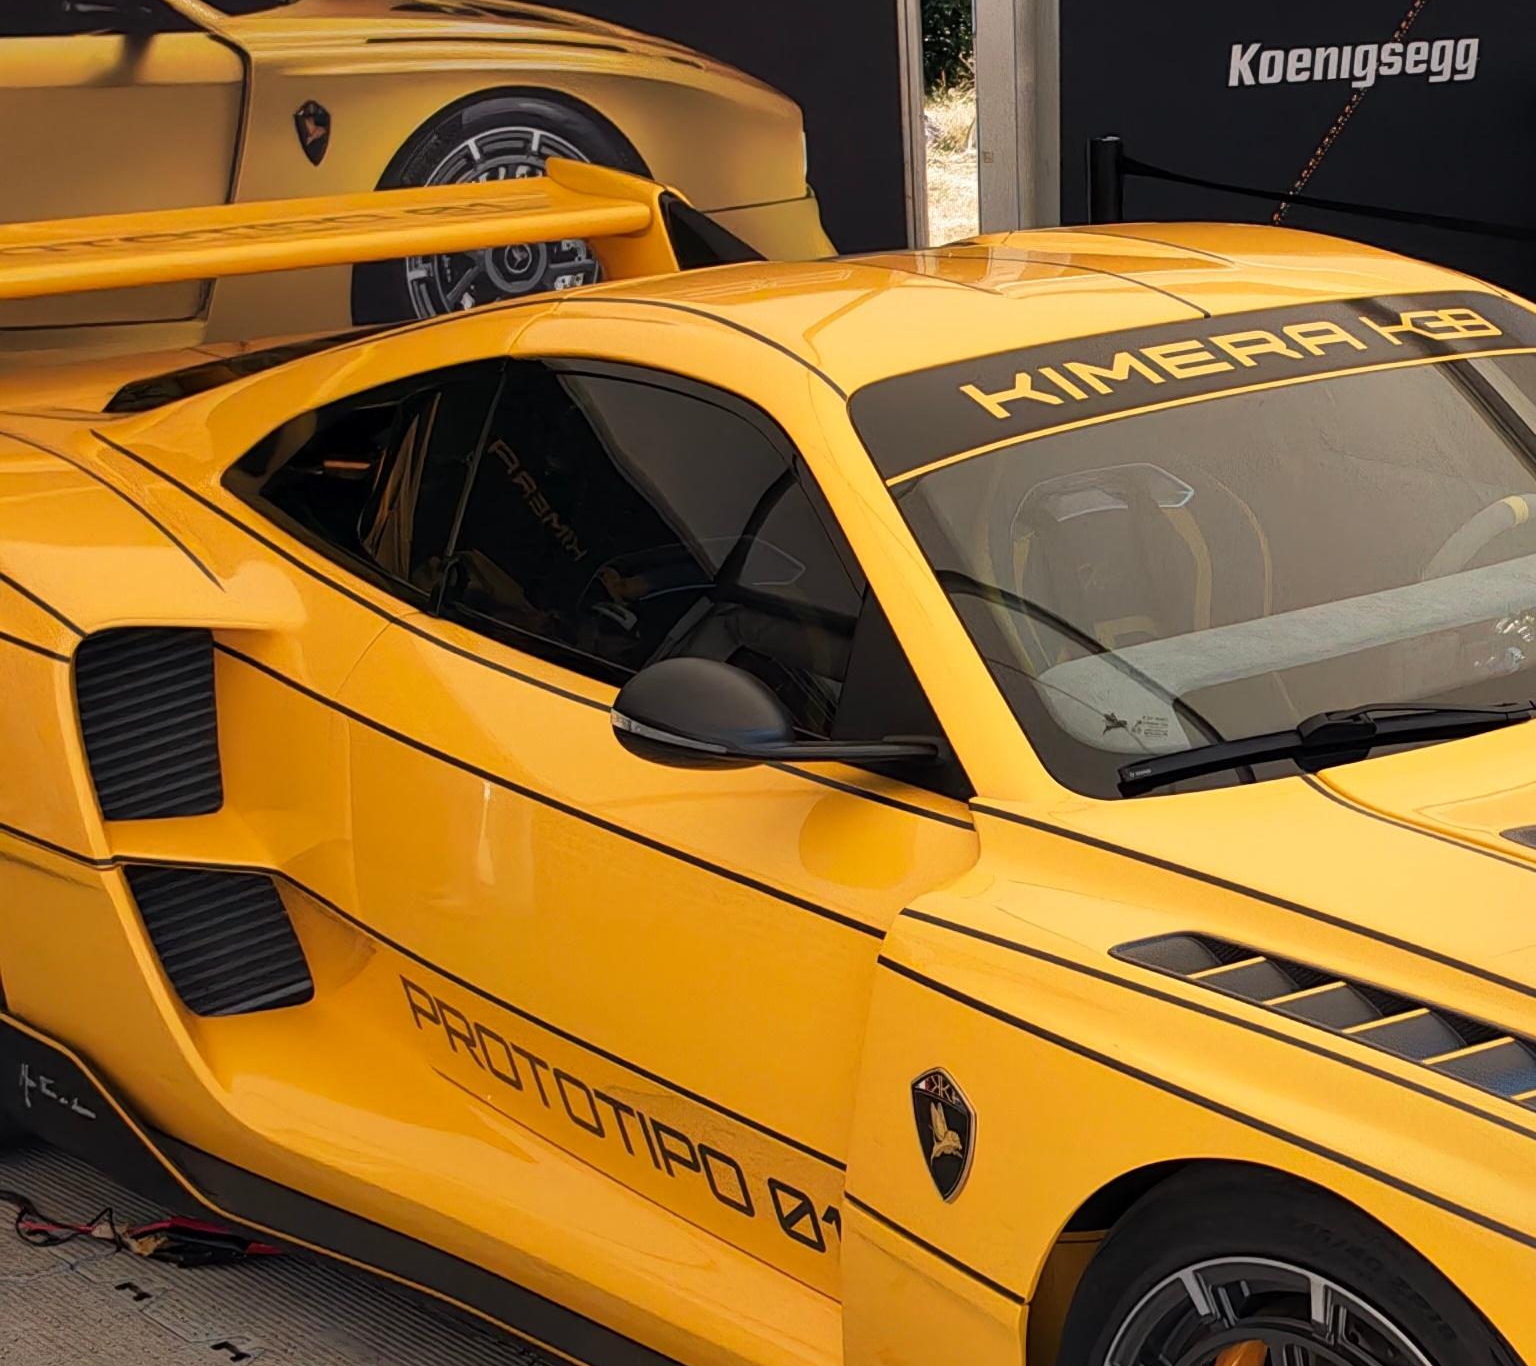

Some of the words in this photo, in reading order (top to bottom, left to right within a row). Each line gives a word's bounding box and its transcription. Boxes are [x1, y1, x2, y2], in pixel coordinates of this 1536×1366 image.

[1227, 38, 1480, 88] Koenigsegg
[959, 320, 1368, 420] KIMERA
[1359, 307, 1504, 346] K39
[400, 973, 756, 1218] PROTOTIPO
